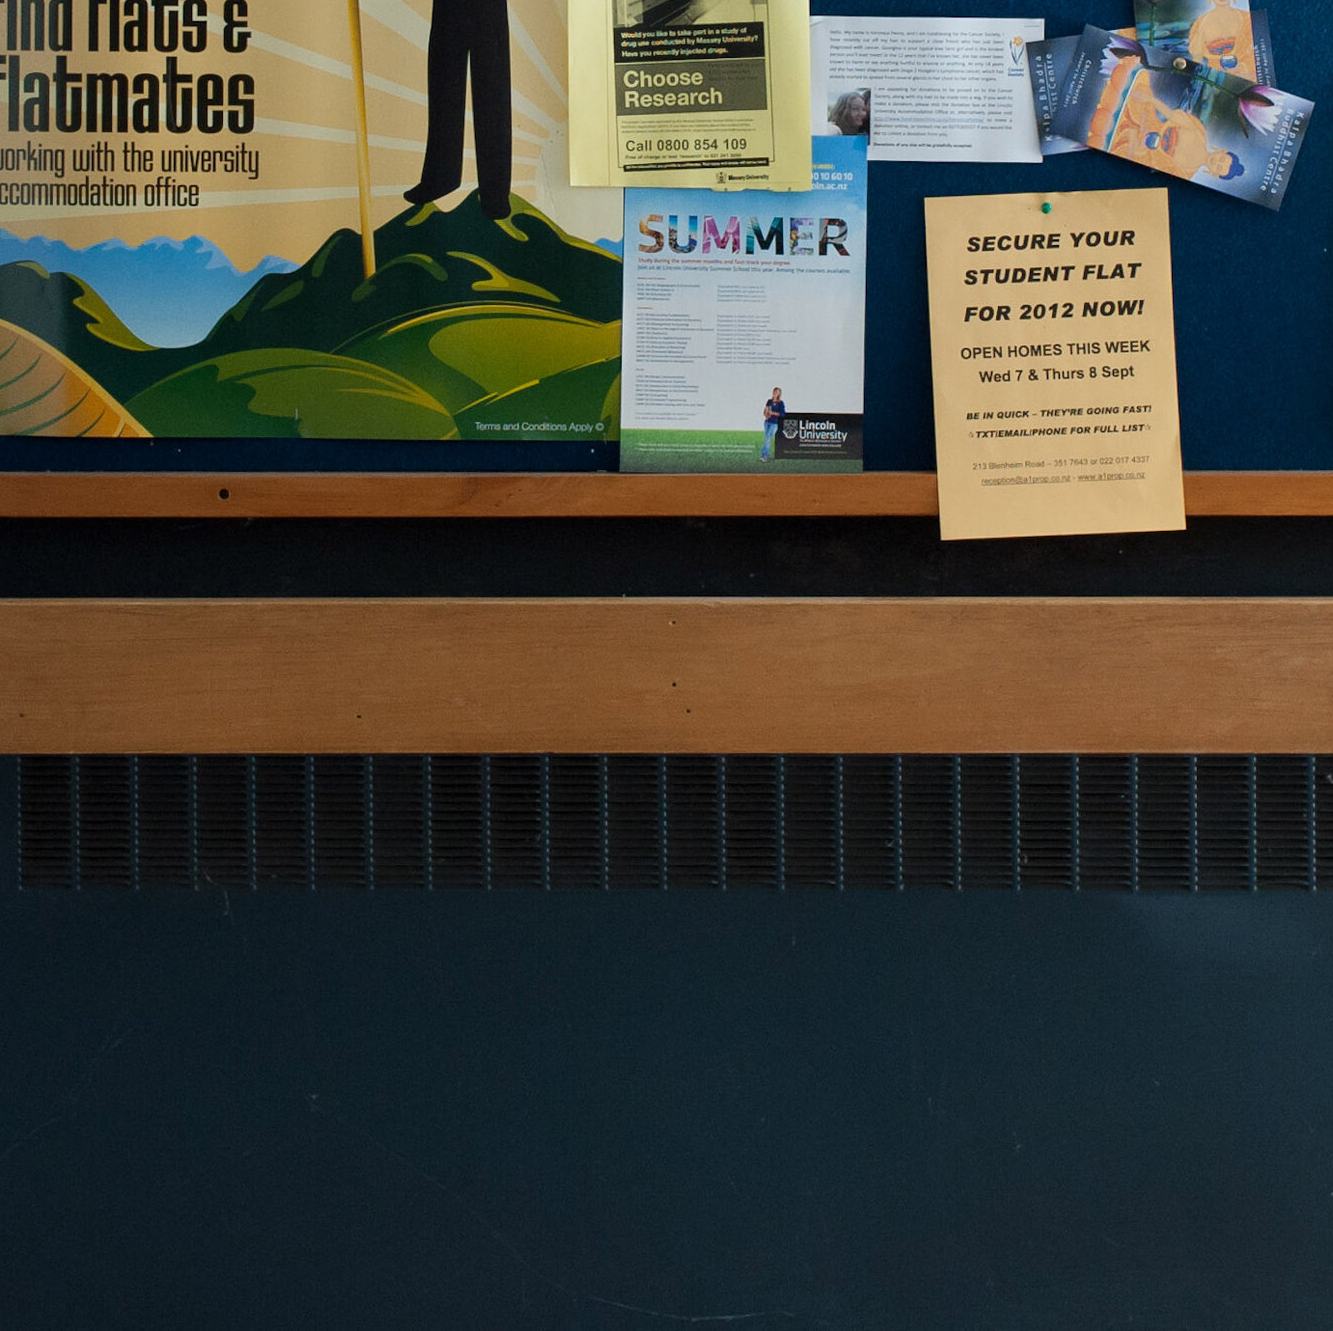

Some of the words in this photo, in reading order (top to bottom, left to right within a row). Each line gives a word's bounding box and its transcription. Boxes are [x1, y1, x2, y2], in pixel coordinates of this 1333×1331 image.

[623, 70, 703, 87] Choose
[625, 87, 722, 107] Research
[625, 140, 651, 151] Call
[657, 139, 689, 151] 0800
[694, 139, 718, 150] 854
[723, 138, 746, 149] 109
[73, 141, 114, 179] with
[122, 141, 153, 172] the
[157, 142, 259, 179] university
[144, 176, 199, 206] office
[638, 214, 851, 256] SUMMER
[967, 233, 1060, 252] SECURE
[1070, 230, 1134, 247] YOUR
[964, 266, 1075, 285] STUDENT
[1082, 262, 1141, 280] FLAT
[964, 305, 1010, 322] FOR
[1019, 303, 1073, 319] 2012
[1082, 300, 1144, 317] NOW!
[961, 346, 1002, 359] OPEN
[1007, 344, 1062, 357] HOMES
[1066, 342, 1100, 355] THIS
[1105, 340, 1150, 353] WEEK
[979, 370, 1010, 382] Wed
[1015, 370, 1023, 381] 7
[1028, 369, 1038, 381] &
[1043, 368, 1084, 380] Thurs
[1089, 366, 1097, 378] 8
[1102, 365, 1134, 379] Sept
[474, 421, 501, 430] Terms
[502, 422, 519, 430] and
[521, 422, 567, 431] Conditions
[568, 422, 593, 432] Apply
